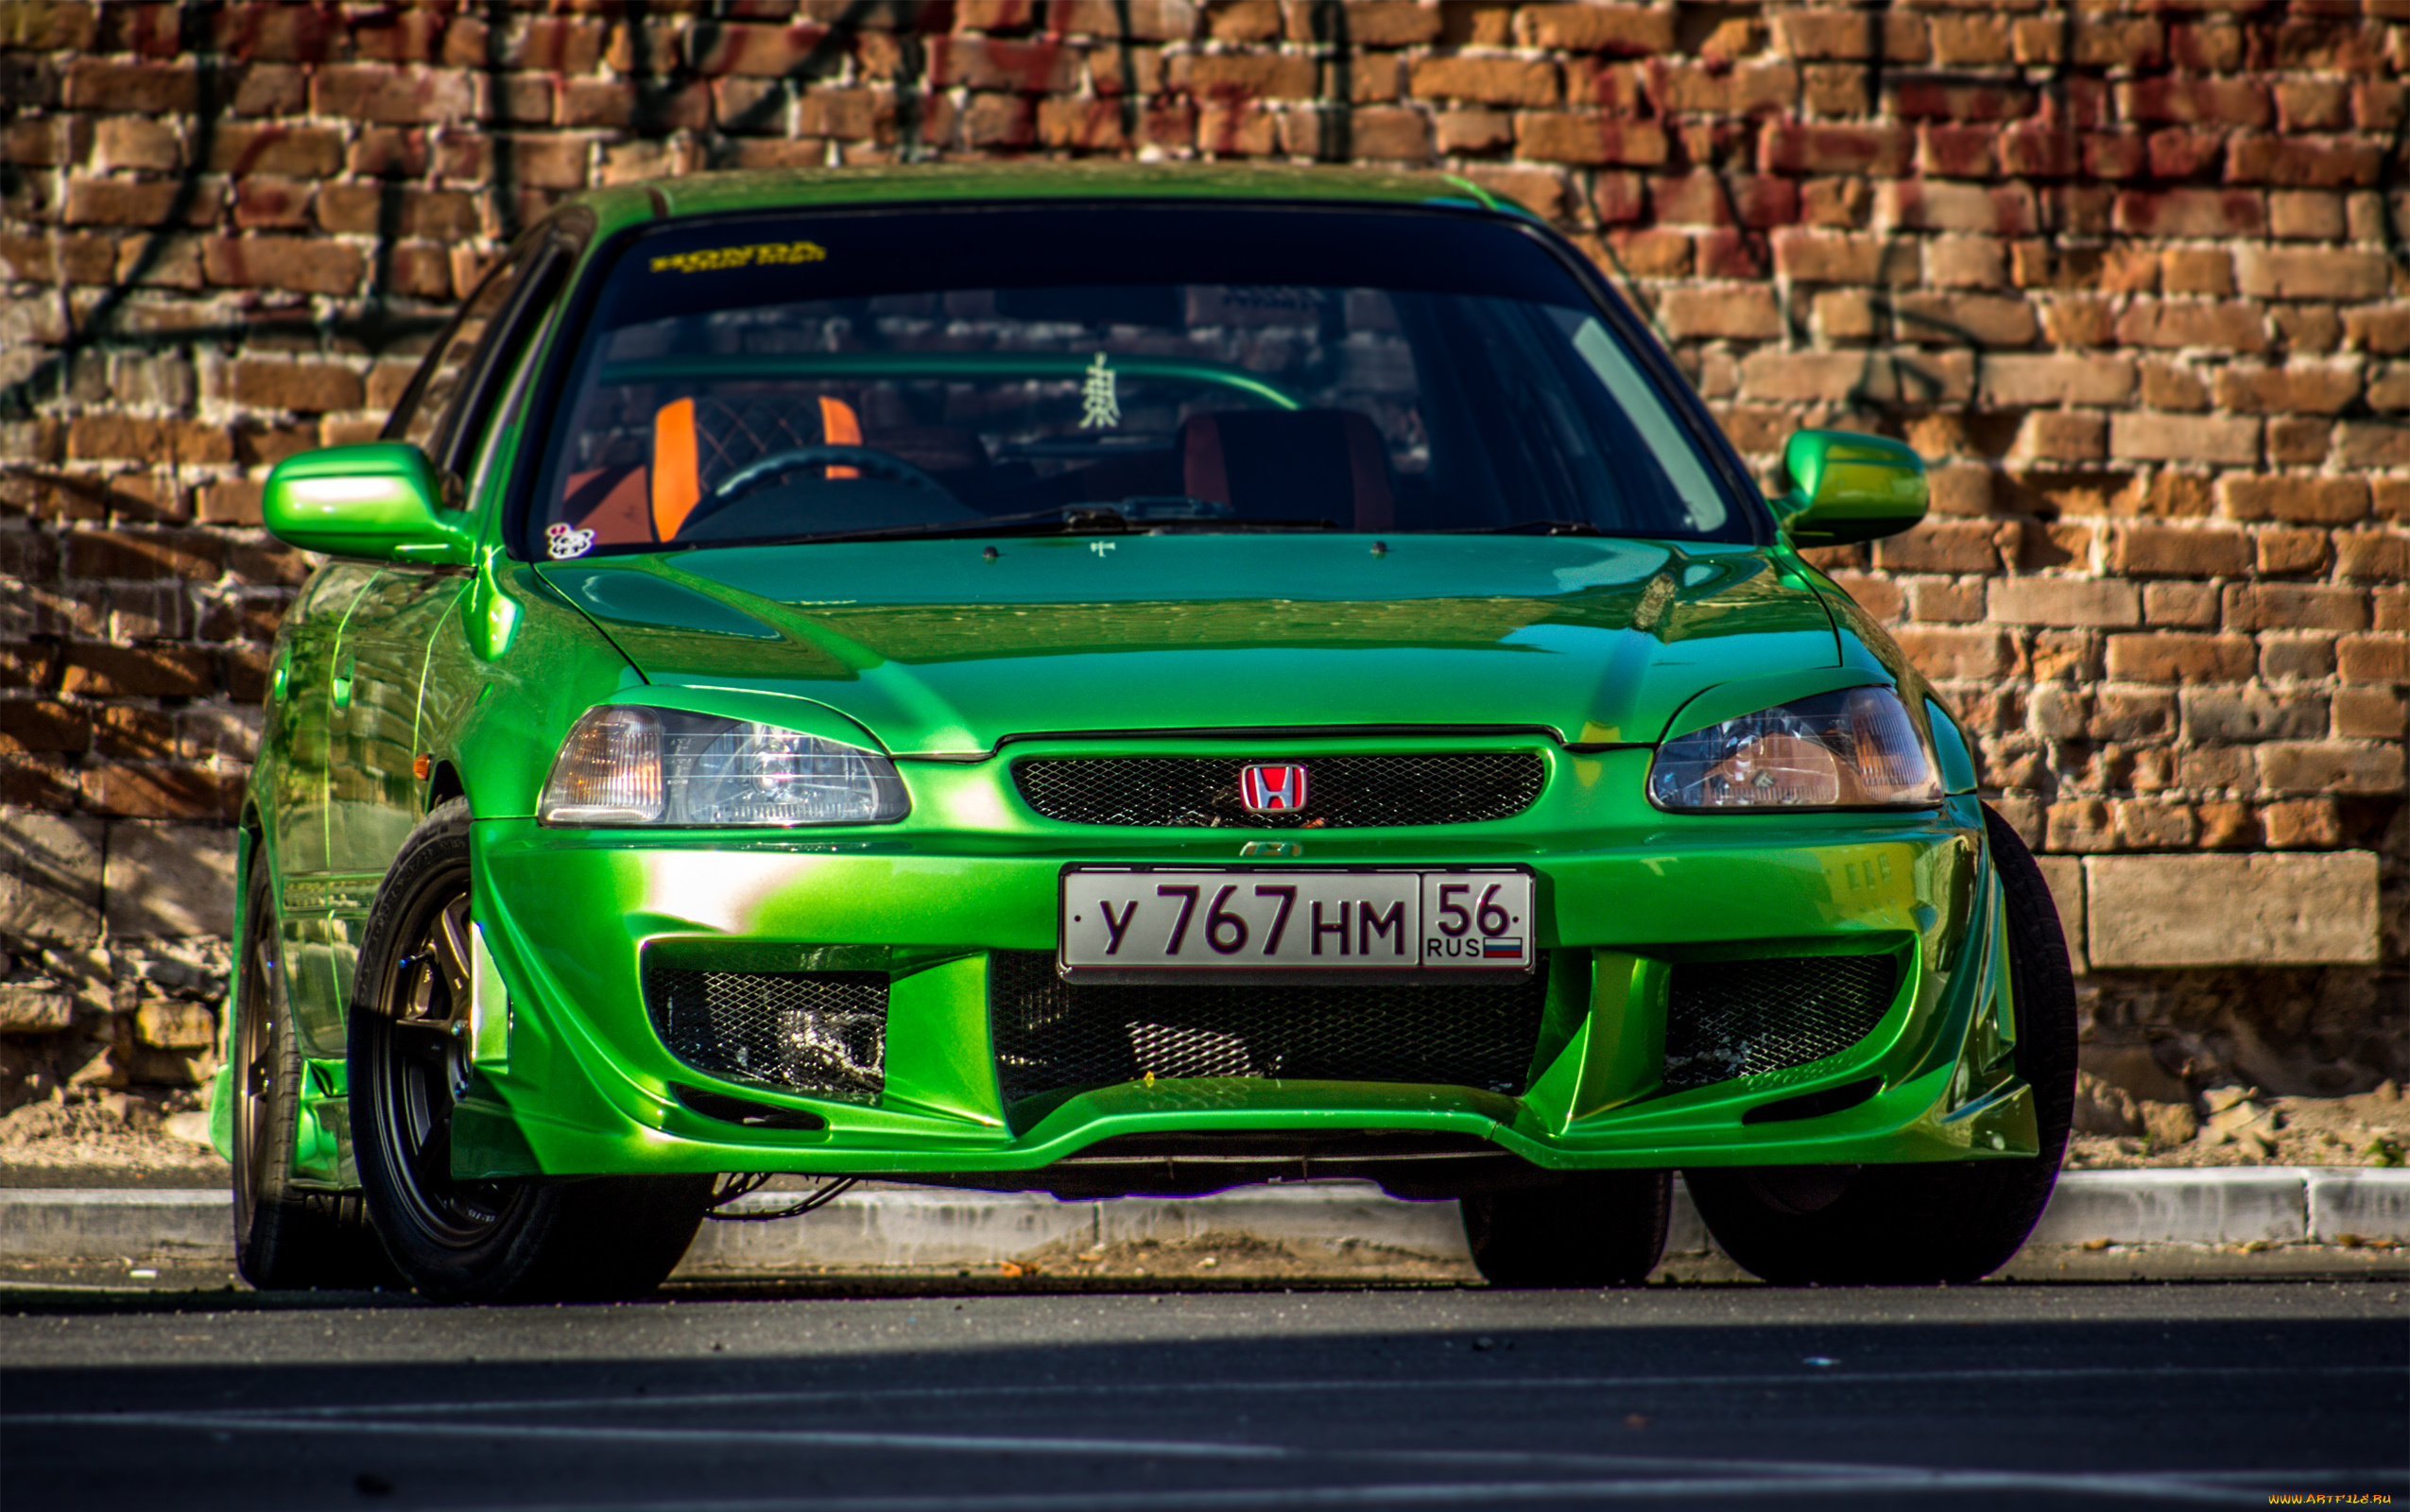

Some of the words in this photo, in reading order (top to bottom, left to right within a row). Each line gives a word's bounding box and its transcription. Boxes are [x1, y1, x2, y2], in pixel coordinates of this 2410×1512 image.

[650, 241, 825, 273] HONDA
[1156, 885, 1298, 956] 767
[1436, 885, 1509, 937] 56
[1426, 938, 1481, 957] RUS
